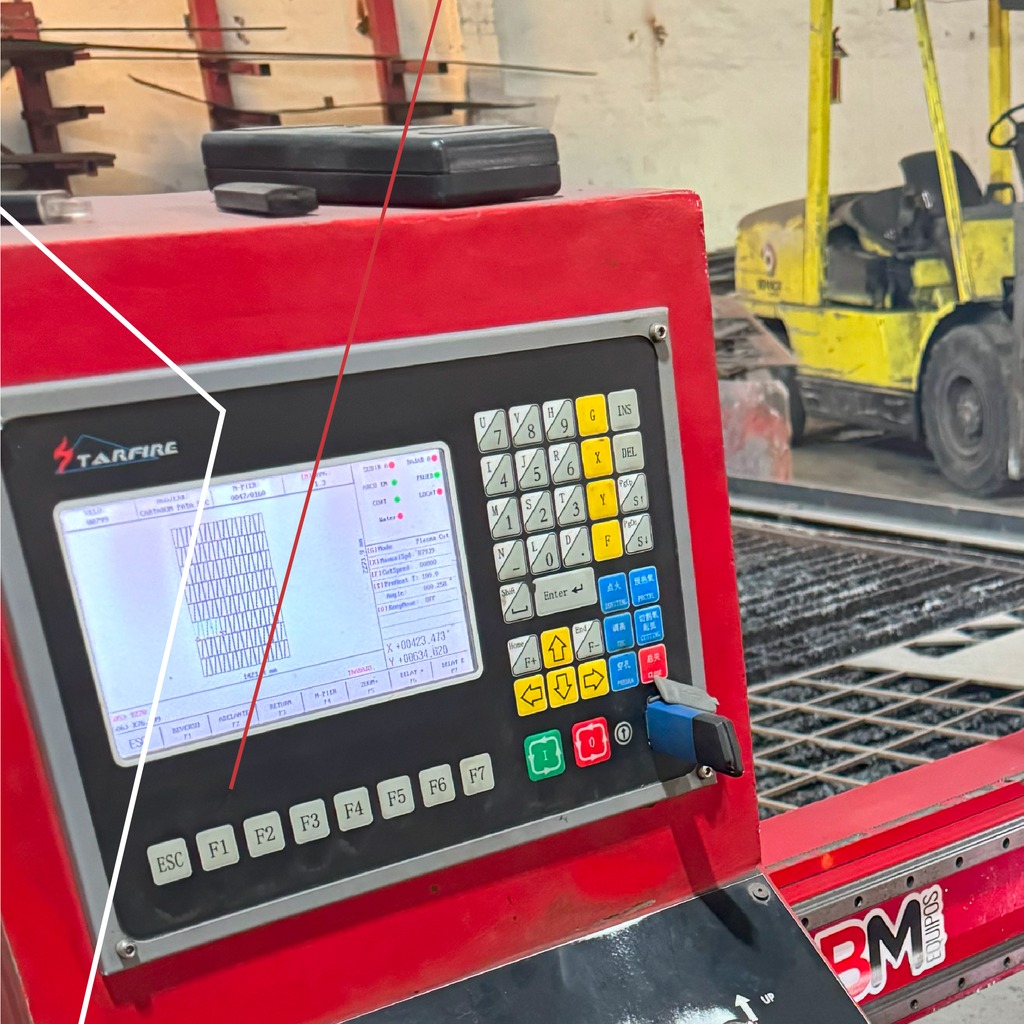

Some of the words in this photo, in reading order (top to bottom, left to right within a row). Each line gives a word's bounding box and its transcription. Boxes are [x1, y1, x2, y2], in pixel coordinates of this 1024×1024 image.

[547, 407, 555, 418] H
[589, 409, 596, 421] G
[617, 404, 632, 417] INS
[479, 417, 486, 429] U
[513, 412, 520, 424] V
[527, 423, 536, 439] 8
[560, 418, 569, 433] 9
[493, 429, 502, 445] 7
[553, 450, 560, 461] R
[594, 451, 601, 464] X
[621, 446, 637, 458] DEL
[486, 462, 492, 473] I
[521, 455, 526, 468] J
[533, 466, 541, 482] 5
[566, 462, 575, 476] 6
[500, 473, 508, 488] 4
[559, 492, 565, 504] T
[600, 493, 605, 506] Y
[491, 505, 498, 516] M
[525, 499, 532, 510] S
[573, 502, 580, 517] 3
[539, 508, 548, 523] 2
[506, 515, 513, 530] 1
[565, 535, 571, 545] D
[605, 535, 611, 547] F
[531, 542, 538, 552] L
[497, 548, 505, 560] N
[546, 552, 553, 567] 0
[501, 586, 516, 597] Shift
[543, 589, 568, 601] Enter
[575, 624, 587, 634] End
[509, 641, 524, 650] Home
[524, 657, 537, 668] F+
[156, 851, 185, 874] ESC
[208, 838, 230, 859] F1
[255, 825, 276, 845] F2
[299, 813, 320, 833] F3
[343, 801, 365, 820] F4
[387, 788, 406, 808] F5
[428, 777, 448, 796] F6
[469, 765, 486, 784] F7
[820, 899, 923, 998] BM
[923, 890, 942, 963] EQUIPOS
[760, 993, 775, 1005] UP
